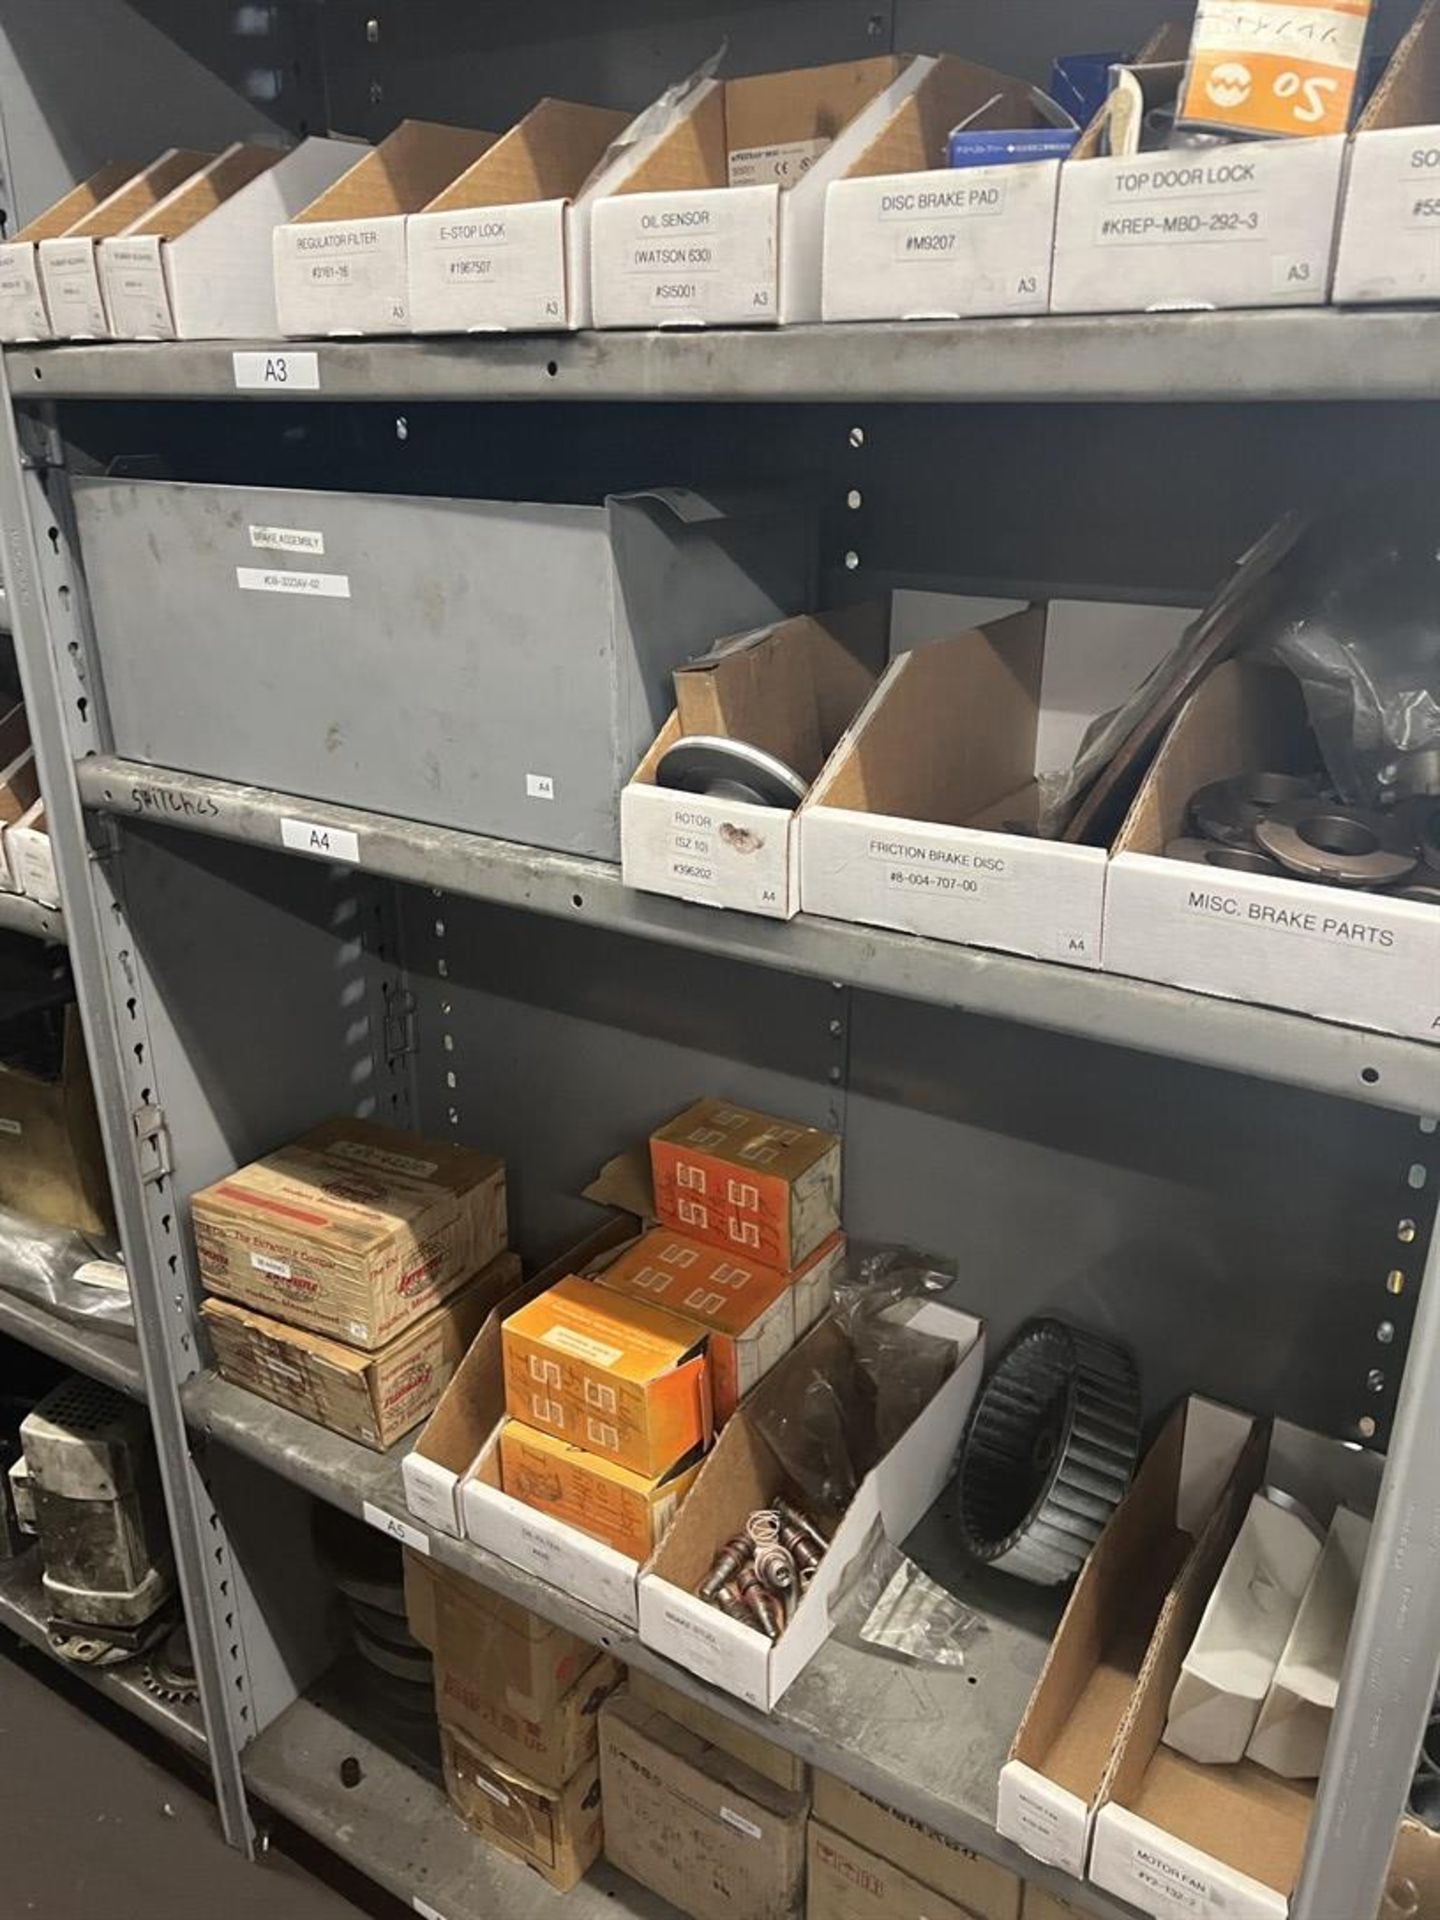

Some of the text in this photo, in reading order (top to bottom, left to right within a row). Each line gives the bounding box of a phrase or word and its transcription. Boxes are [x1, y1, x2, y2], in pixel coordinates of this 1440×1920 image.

[1115, 164, 1255, 191] TOP DOOR LOCK
[881, 188, 999, 211] DISC BRAKE PAD
[641, 211, 710, 229] OIL SENSOR
[1101, 212, 1258, 235] #KREP-MBD-292-3
[296, 231, 377, 250] REGULATOR FILTER
[440, 223, 506, 240] E-STOP LOCK
[905, 234, 956, 250] #M9207
[634, 248, 711, 264] (WATSON 630)
[1288, 263, 1310, 281] A3
[1017, 277, 1037, 293] A3
[545, 301, 559, 315] A3
[753, 291, 768, 307] A3
[392, 305, 405, 319] A3
[264, 358, 288, 382] A3
[538, 782, 550, 793] A4
[674, 811, 712, 828] ROTOR
[309, 830, 330, 850] A4
[869, 840, 1005, 872] FRICTION BRAKE DISC
[890, 872, 978, 892] #8-004-707-00
[762, 890, 776, 902] A4
[1188, 891, 1395, 947] MISC. BRAKE PARTS
[1068, 939, 1085, 951] A4
[387, 1520, 405, 1538] A5
[1137, 1849, 1206, 1892] MOTOR FAN
